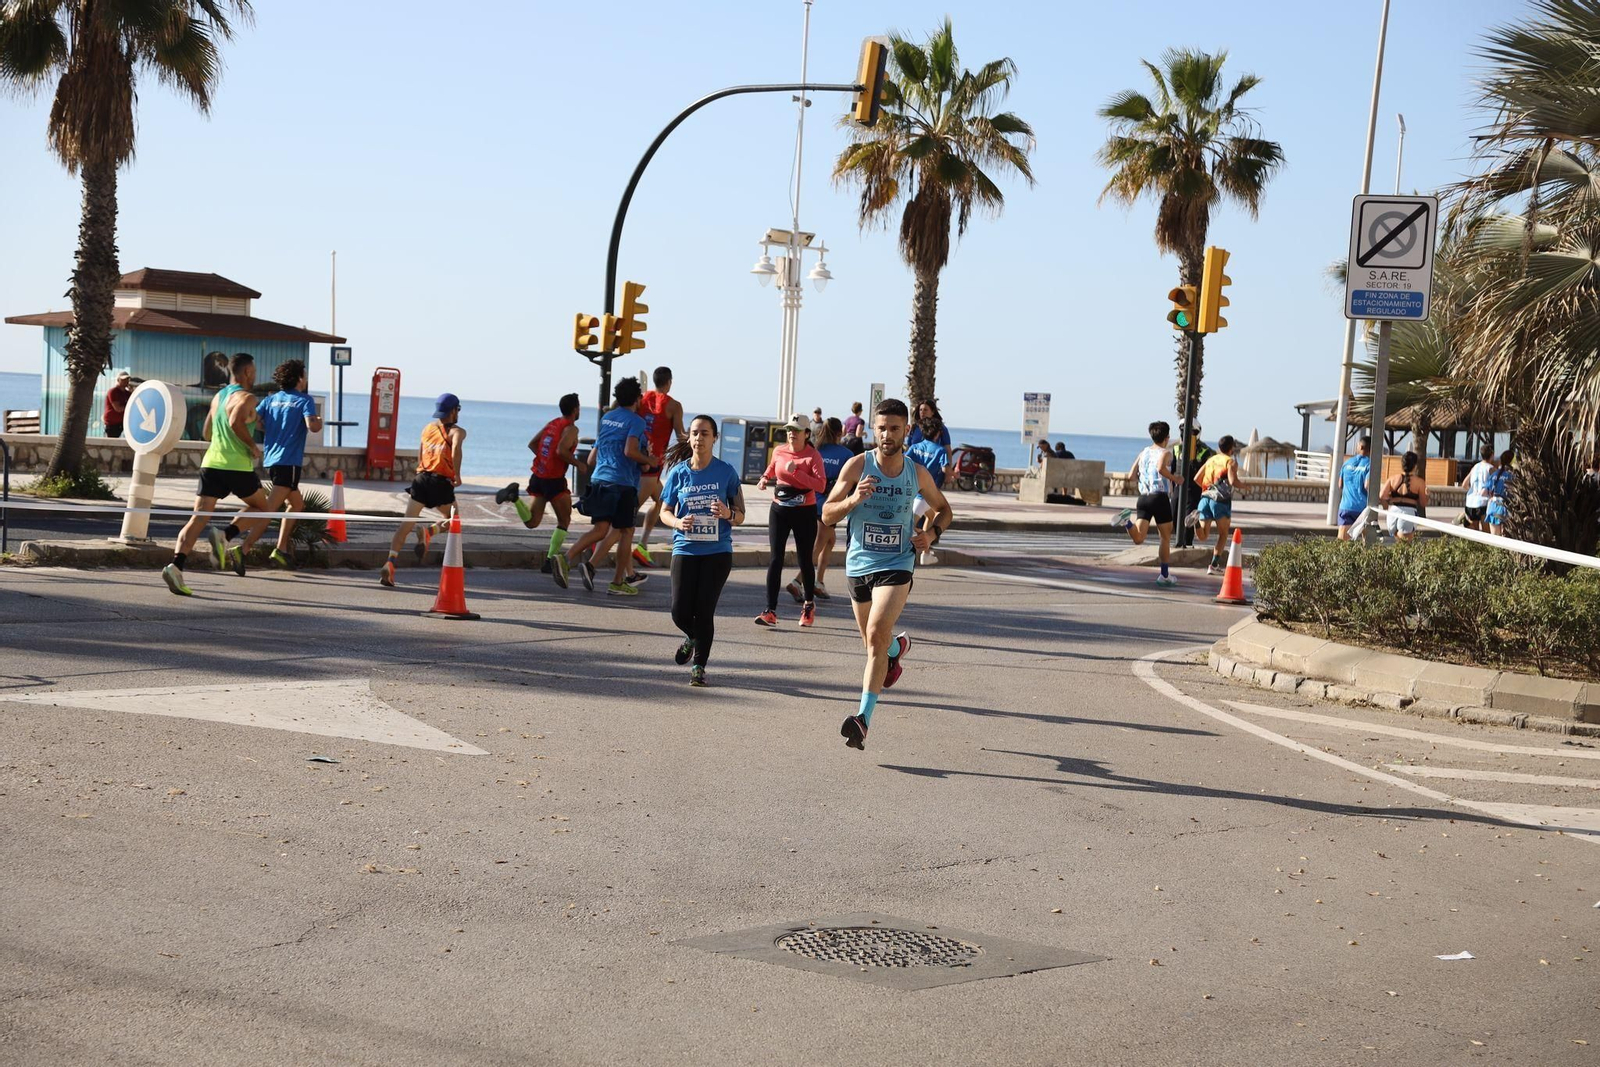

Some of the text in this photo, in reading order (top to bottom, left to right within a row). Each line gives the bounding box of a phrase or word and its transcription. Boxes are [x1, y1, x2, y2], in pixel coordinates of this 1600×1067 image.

[1353, 300, 1421, 308] ESTACIONAMIENTO
[682, 482, 720, 493] mayoral
[872, 484, 903, 497] erja
[868, 533, 897, 544] 1647
